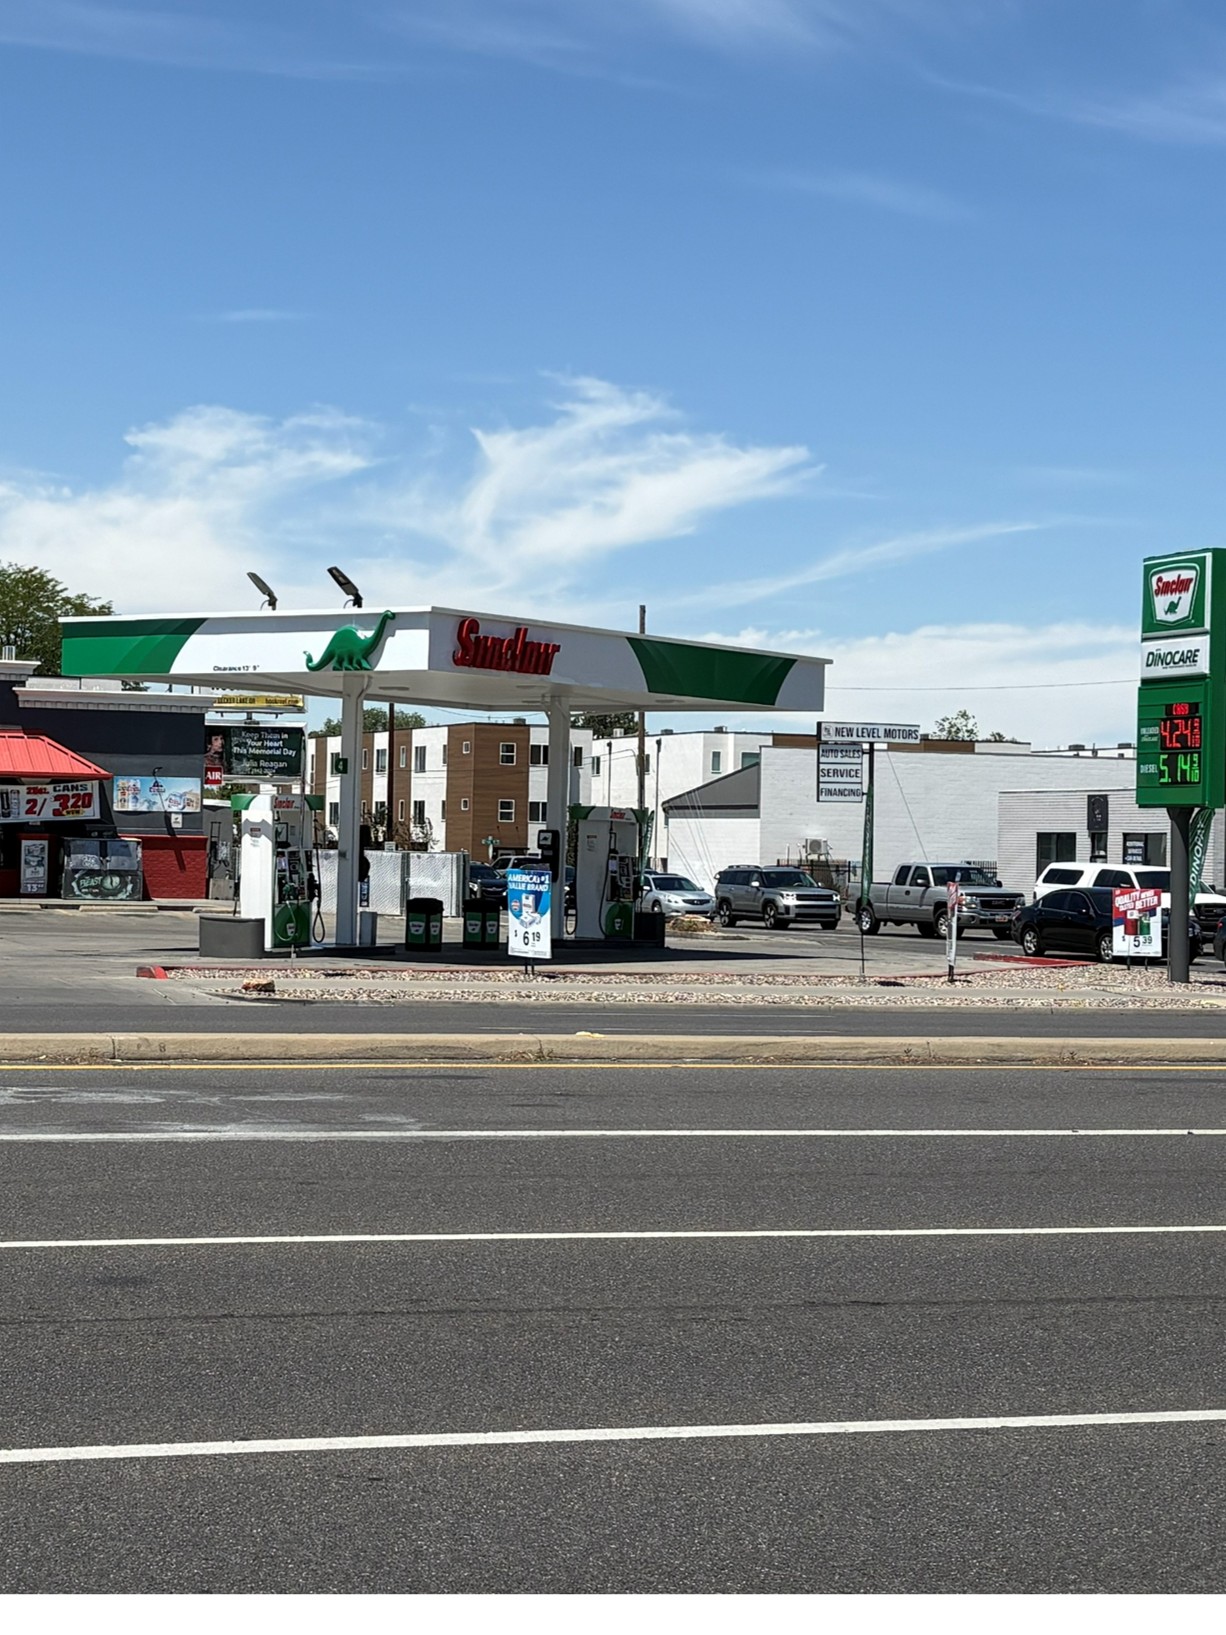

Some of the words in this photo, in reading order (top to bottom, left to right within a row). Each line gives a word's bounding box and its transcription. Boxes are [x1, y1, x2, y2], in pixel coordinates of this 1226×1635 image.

[1154, 574, 1194, 597] Sinclair
[1146, 649, 1200, 667] DINOCARE
[242, 731, 260, 740] Keep
[835, 727, 854, 737] NEW
[856, 727, 881, 738] LEVEL
[884, 728, 919, 739] MOTORS
[233, 746, 247, 754] This
[248, 747, 282, 755] Memorial
[282, 748, 296, 757] Day
[821, 749, 839, 758] AUTO
[840, 749, 861, 759] SALES
[259, 760, 288, 769] Reagan
[338, 761, 343, 771] 4
[1140, 764, 1158, 773] DIESEL
[206, 771, 221, 780] AIR
[820, 768, 861, 778] SERVICE
[53, 784, 88, 793] CANS
[820, 788, 861, 797] FINANCING
[79, 877, 103, 889] BEAST
[508, 882, 526, 890] VALUE
[527, 884, 549, 892] BRAND
[1135, 896, 1159, 910] BETTER
[522, 931, 530, 946] 6
[531, 931, 541, 942] 19
[1133, 936, 1141, 948] 5
[1142, 936, 1153, 944] 39
